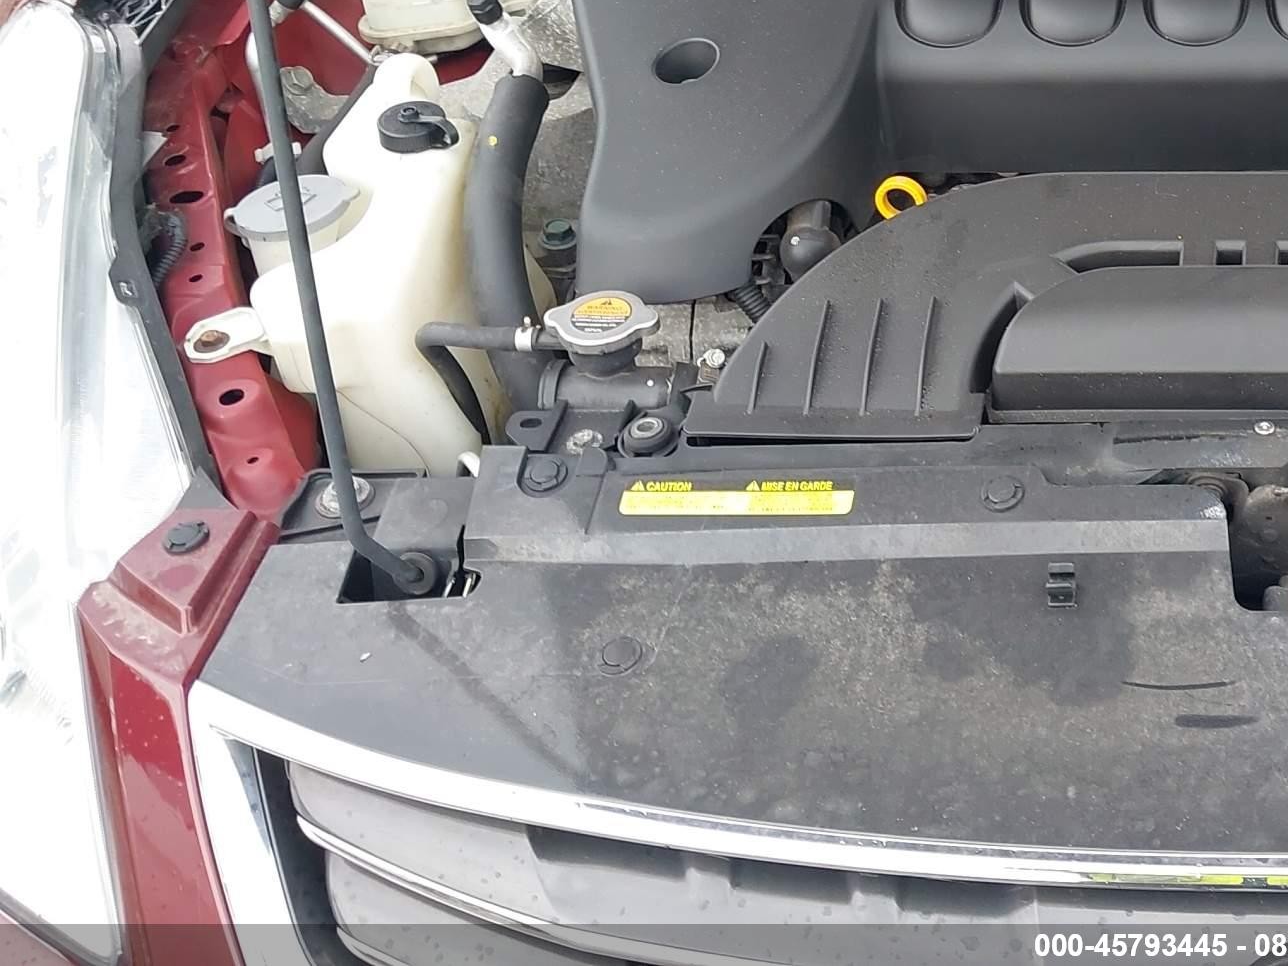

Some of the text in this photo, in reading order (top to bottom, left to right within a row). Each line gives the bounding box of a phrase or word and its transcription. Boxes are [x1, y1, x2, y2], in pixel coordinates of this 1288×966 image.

[645, 481, 692, 492] CAUTION
[761, 480, 834, 491] MISE EN GARDE
